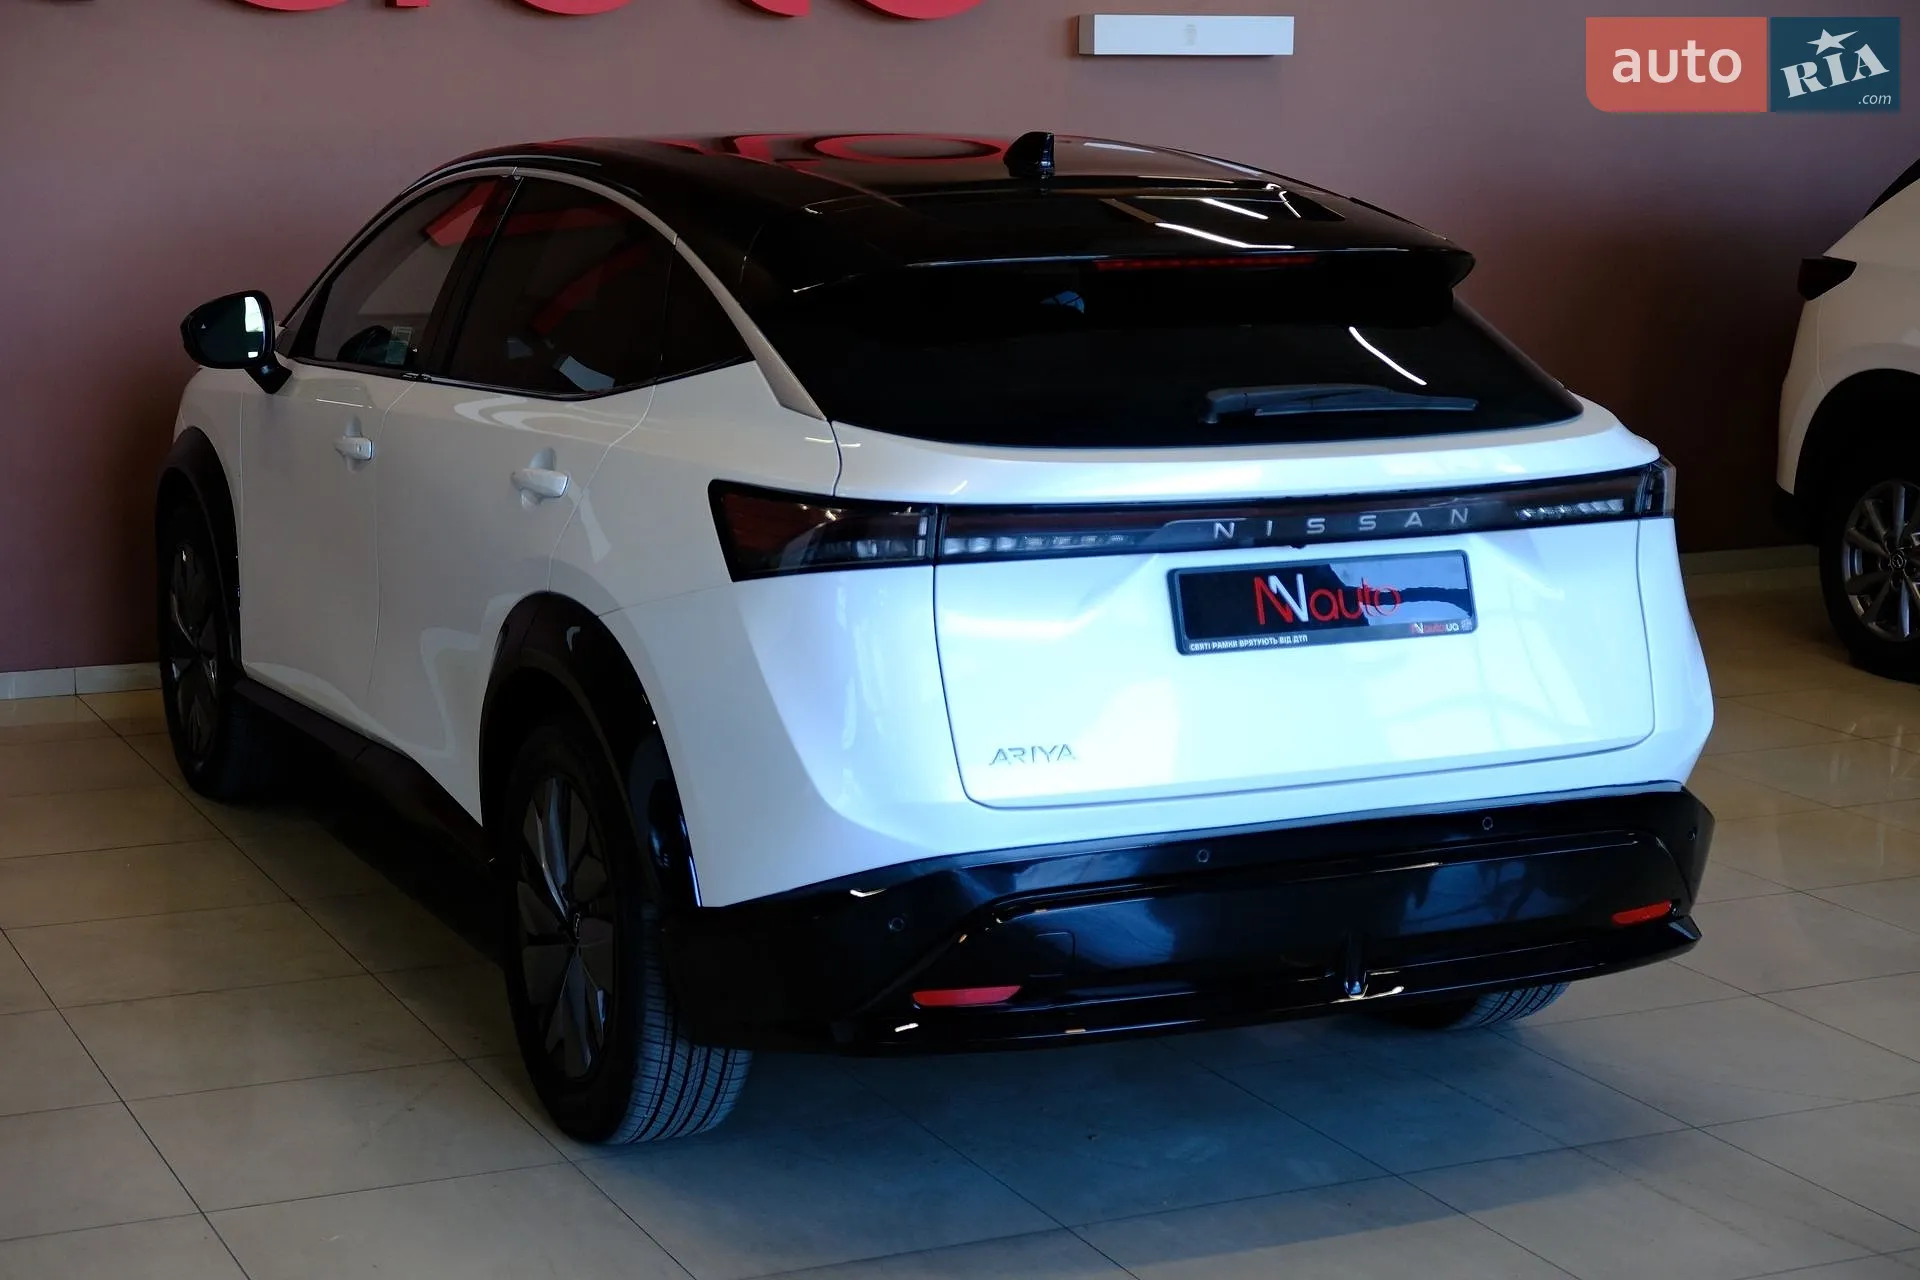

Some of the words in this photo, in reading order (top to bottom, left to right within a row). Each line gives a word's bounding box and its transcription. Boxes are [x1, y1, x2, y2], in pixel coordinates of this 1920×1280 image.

[1213, 508, 1469, 539] NISSAN
[1279, 635, 1292, 645] ВІД
[988, 743, 1077, 766] ARIYA
